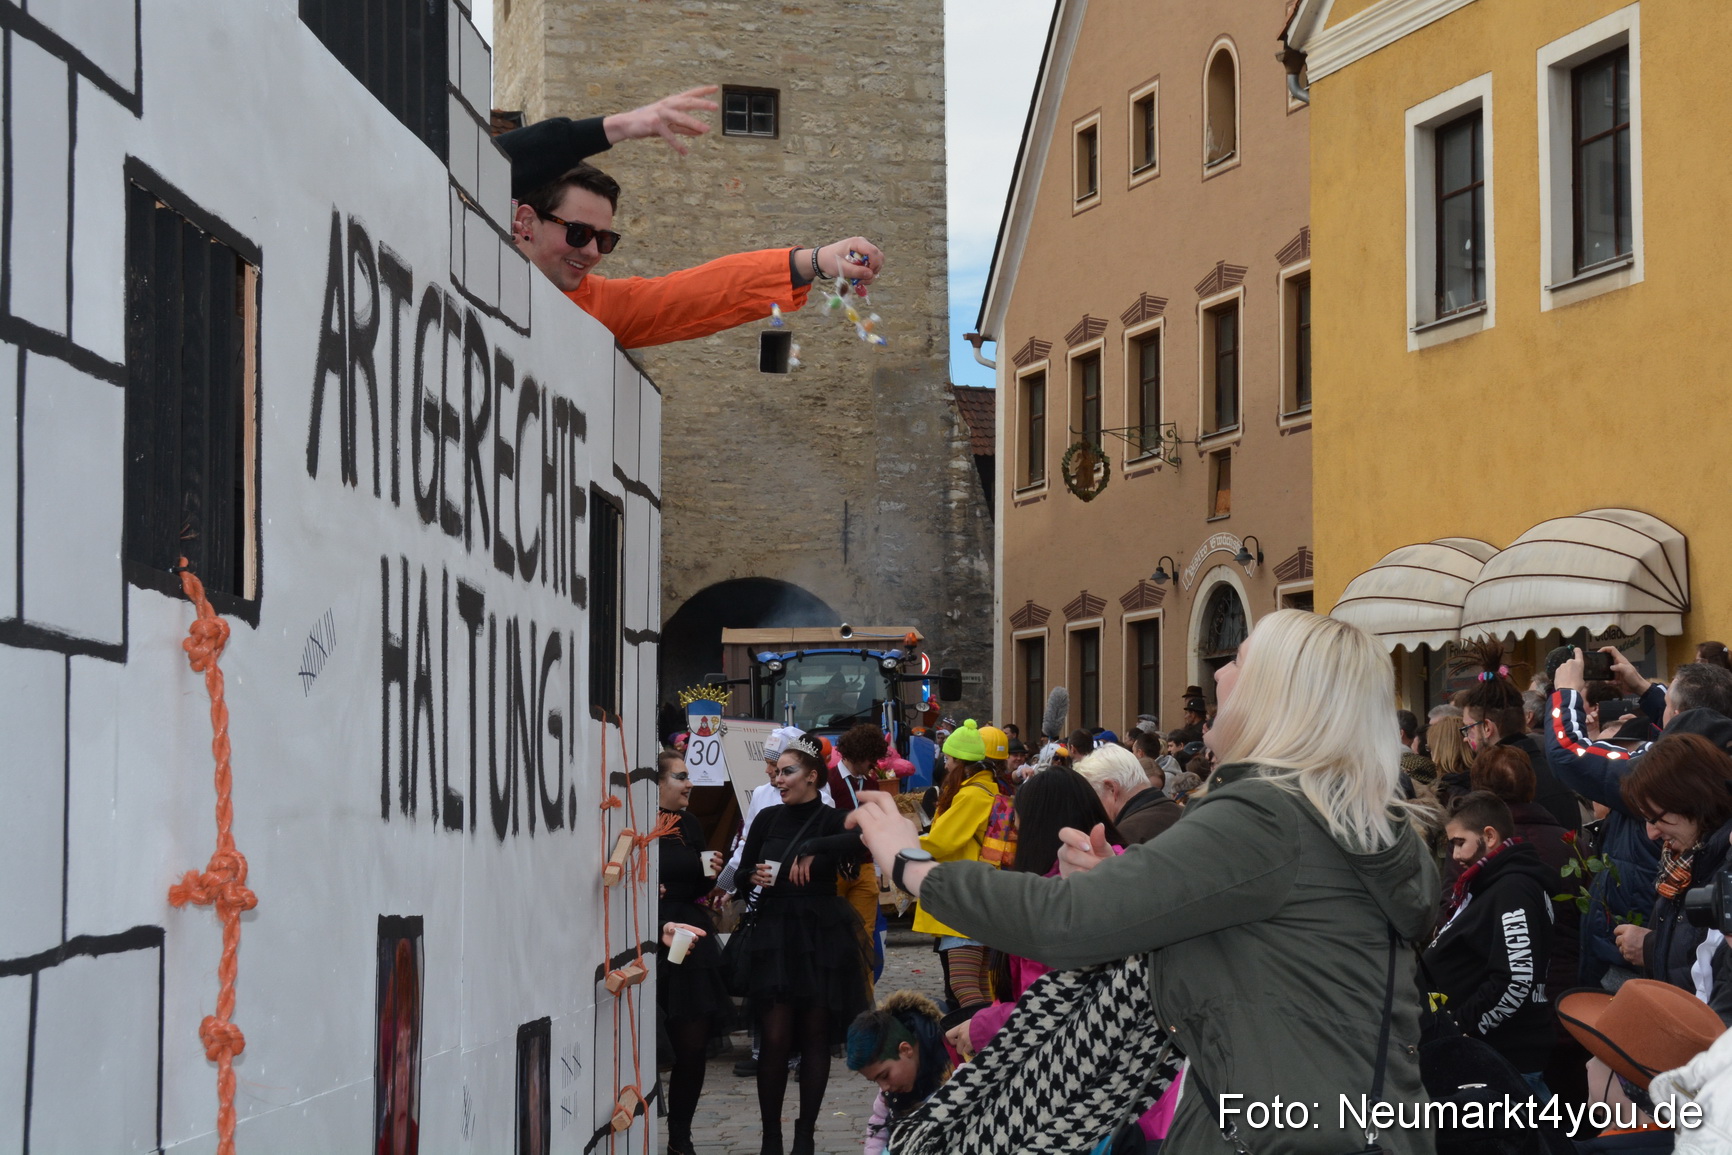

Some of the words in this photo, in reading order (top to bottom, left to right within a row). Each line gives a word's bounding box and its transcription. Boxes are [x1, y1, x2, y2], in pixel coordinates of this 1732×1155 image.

[306, 202, 587, 610] ARTGERECHTE
[380, 554, 578, 842] HALTUNG!
[689, 739, 720, 766] 30
